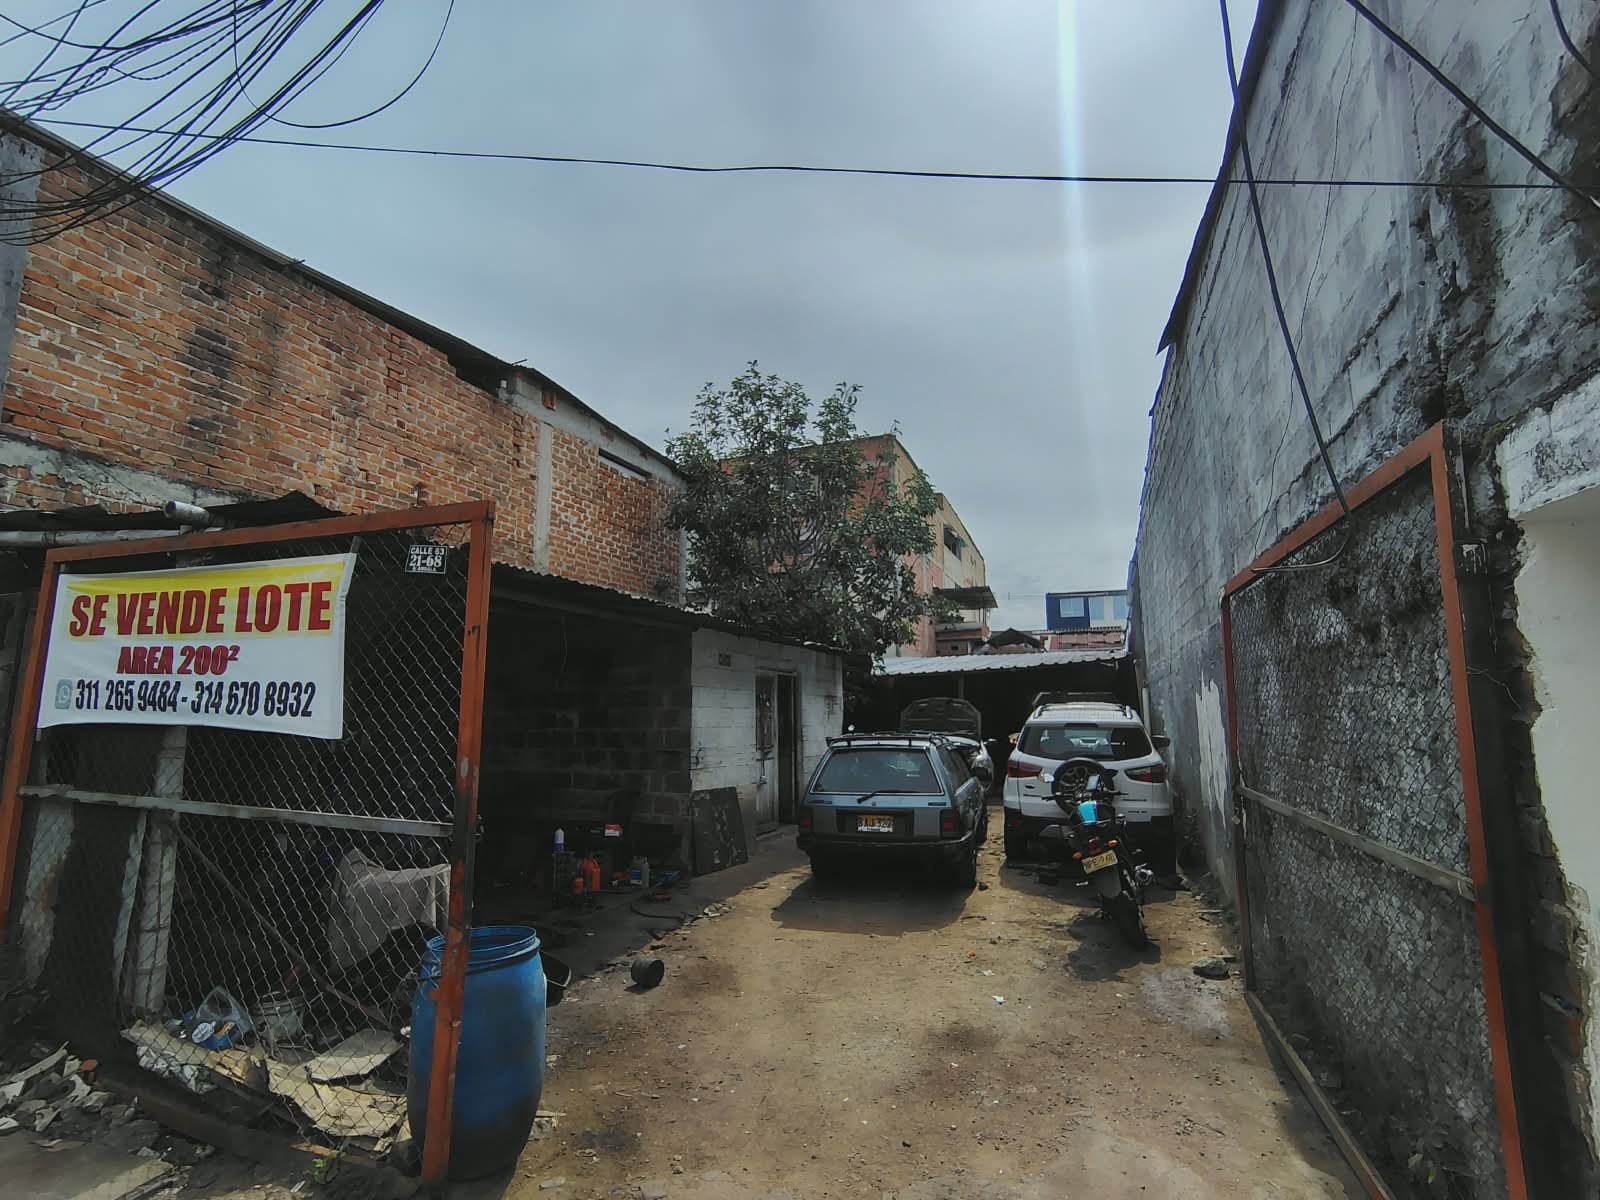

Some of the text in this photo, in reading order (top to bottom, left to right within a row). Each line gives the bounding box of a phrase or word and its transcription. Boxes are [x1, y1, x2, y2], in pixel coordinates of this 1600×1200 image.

[409, 554, 442, 567] 21-68
[69, 581, 332, 637] SE VENDE LOTE
[116, 646, 174, 675] AREA
[75, 678, 100, 710] 311
[104, 679, 136, 711] 265
[137, 679, 182, 713] 9484
[190, 680, 224, 714] 314
[225, 680, 261, 716] 670
[263, 681, 316, 717] 8932
